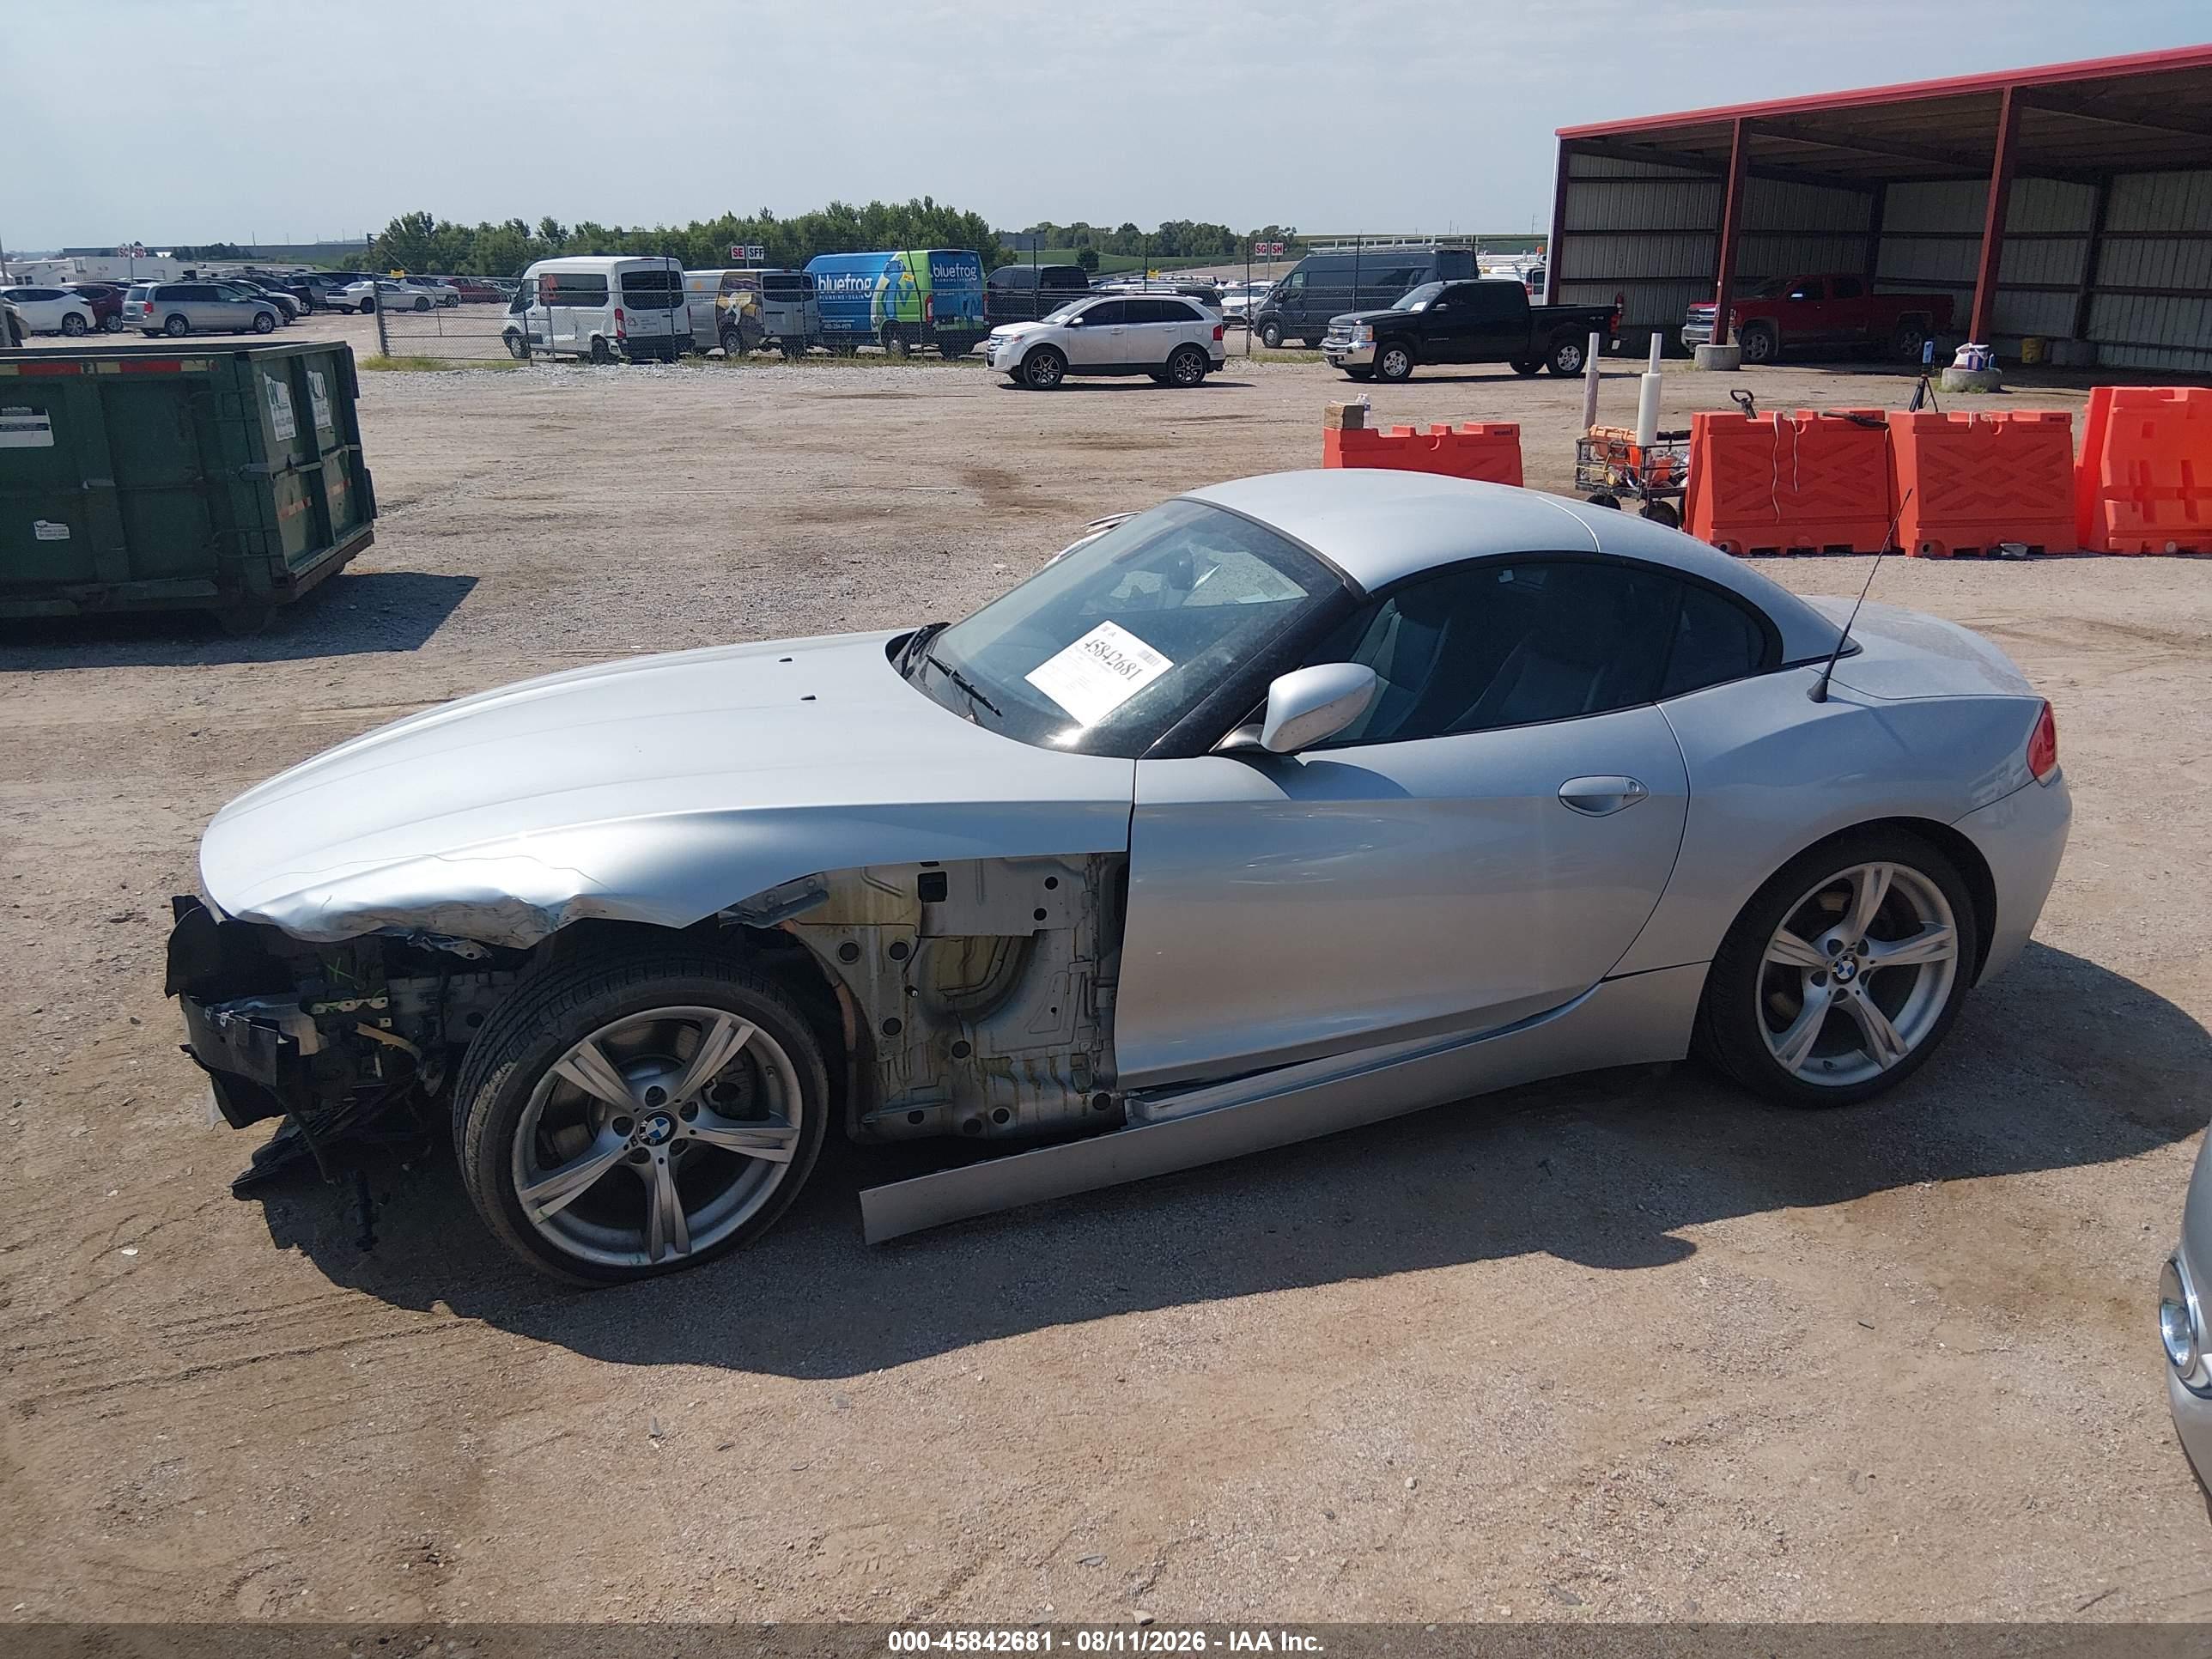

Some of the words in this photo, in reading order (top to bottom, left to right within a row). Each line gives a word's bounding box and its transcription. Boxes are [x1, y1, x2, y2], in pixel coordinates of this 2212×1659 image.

[118, 247, 129, 258] SC
[134, 248, 144, 258] SD
[732, 247, 744, 258] SE
[749, 247, 763, 258] SFF
[1255, 244, 1267, 254] SG
[1272, 245, 1283, 254] SH
[933, 263, 977, 281] bluefrog
[817, 273, 872, 298] bluefrog
[1083, 639, 1144, 681] 45842681
[640, 1120, 656, 1146] BMW
